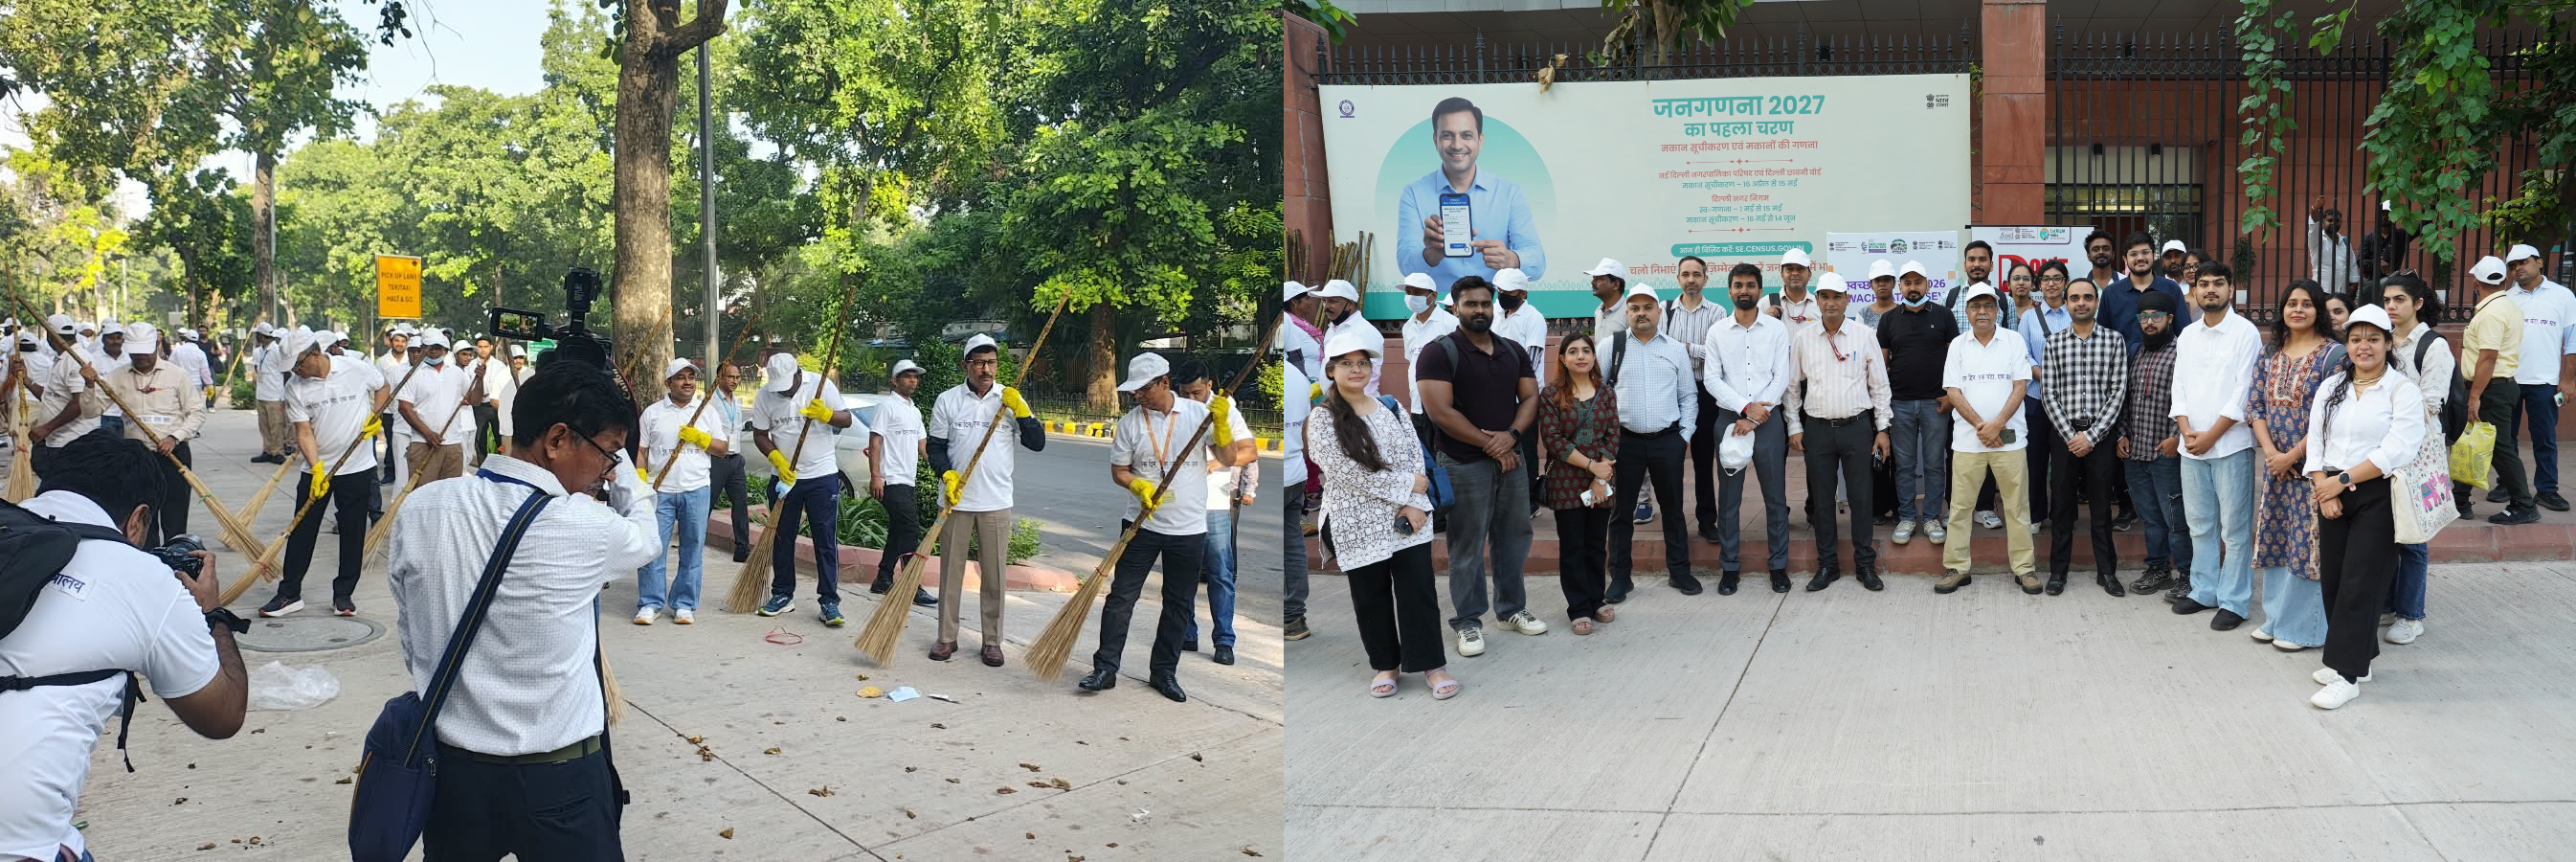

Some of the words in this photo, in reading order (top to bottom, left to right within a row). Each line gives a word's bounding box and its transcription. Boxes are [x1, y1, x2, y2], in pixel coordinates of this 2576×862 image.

[1652, 96, 1763, 118] जनगणना
[1768, 95, 1826, 115] 2027
[1684, 123, 1706, 137] का
[1710, 122, 1753, 138] पहला
[1756, 121, 1794, 135] चरण
[1661, 144, 1688, 153] मकान
[1691, 141, 1729, 154] सूचीकरण
[1731, 141, 1744, 150] एवं
[1746, 139, 1776, 150] मकानों
[1778, 139, 1790, 149] की
[1792, 141, 1818, 149] गणना
[1670, 170, 1690, 179] दिल्ली
[1766, 168, 1785, 176] दिल्ली
[1770, 179, 1777, 187] से
[1712, 194, 1731, 203] दिल्ली
[1750, 193, 1769, 202] निगम
[1735, 244, 1804, 253] SE.CENSUS.GOVIN
[1629, 264, 1649, 275] चलो
[1998, 254, 2068, 292] DO'
[1846, 281, 1871, 291] स्वच्छ
